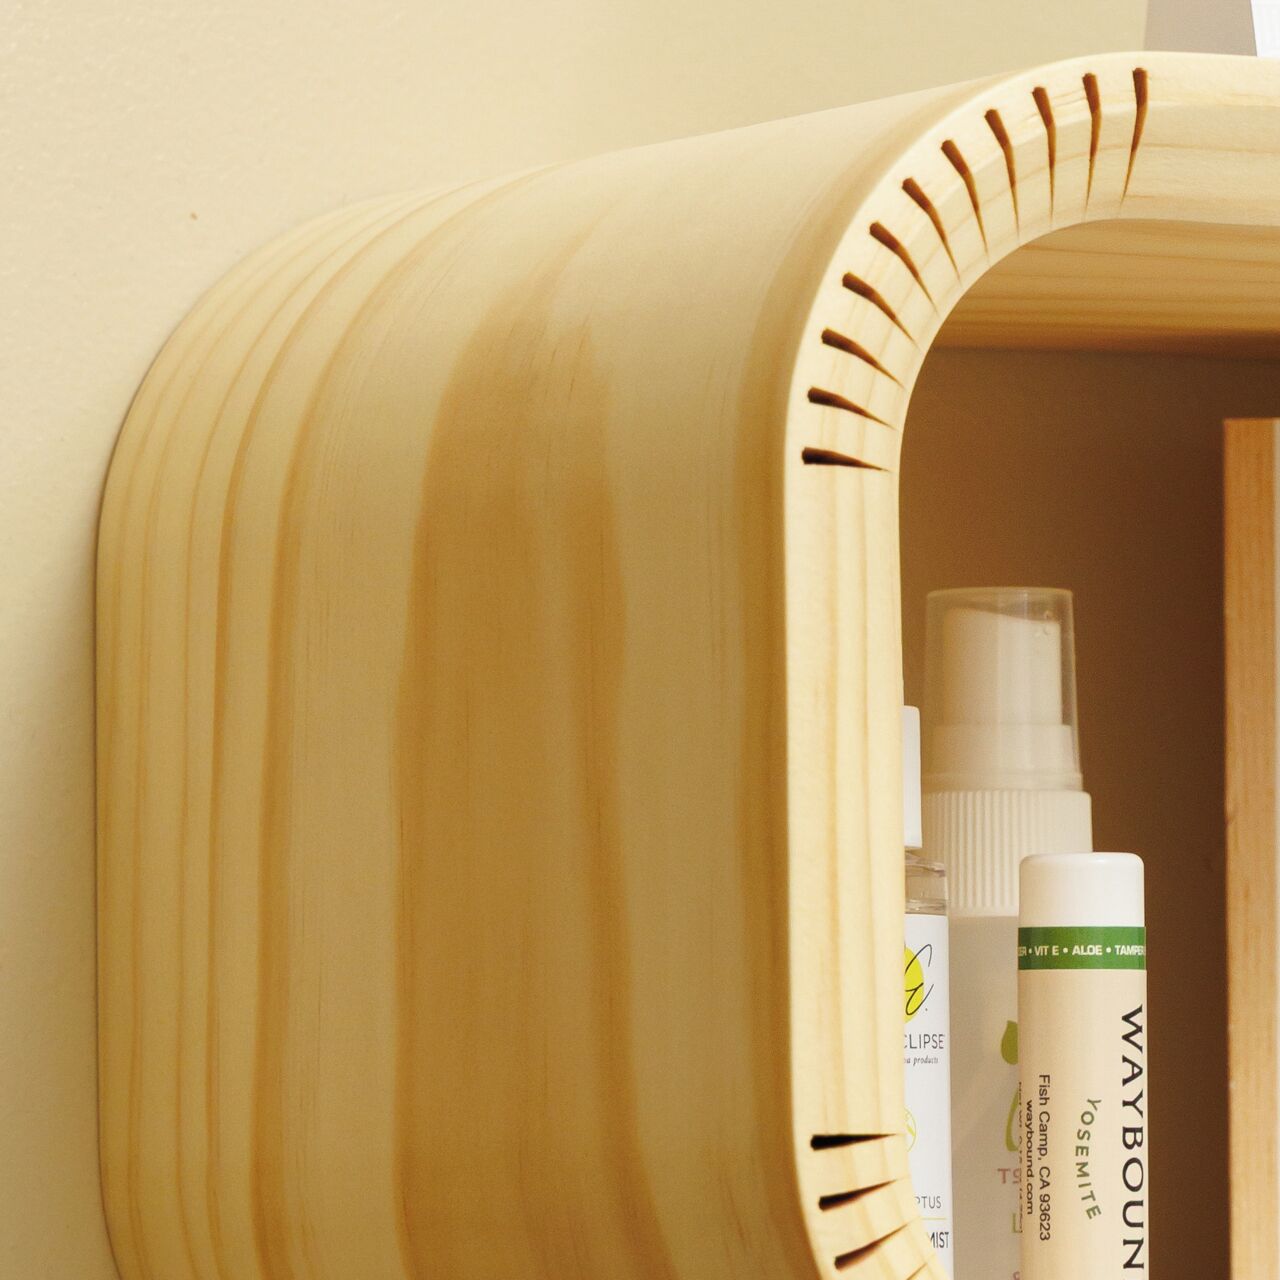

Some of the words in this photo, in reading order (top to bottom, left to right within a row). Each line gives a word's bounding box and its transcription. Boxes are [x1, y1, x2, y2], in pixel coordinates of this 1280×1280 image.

[1034, 946, 1049, 956] VIT
[1052, 945, 1059, 956] E
[1072, 945, 1103, 956] ALOE
[1038, 1074, 1051, 1106] Fish
[1025, 1099, 1036, 1215] waybound.com
[1037, 1111, 1051, 1161] Camp,
[1075, 1097, 1102, 1220] YOSEMITE
[1039, 1166, 1051, 1190] CA
[1039, 1193, 1051, 1241] 93623
